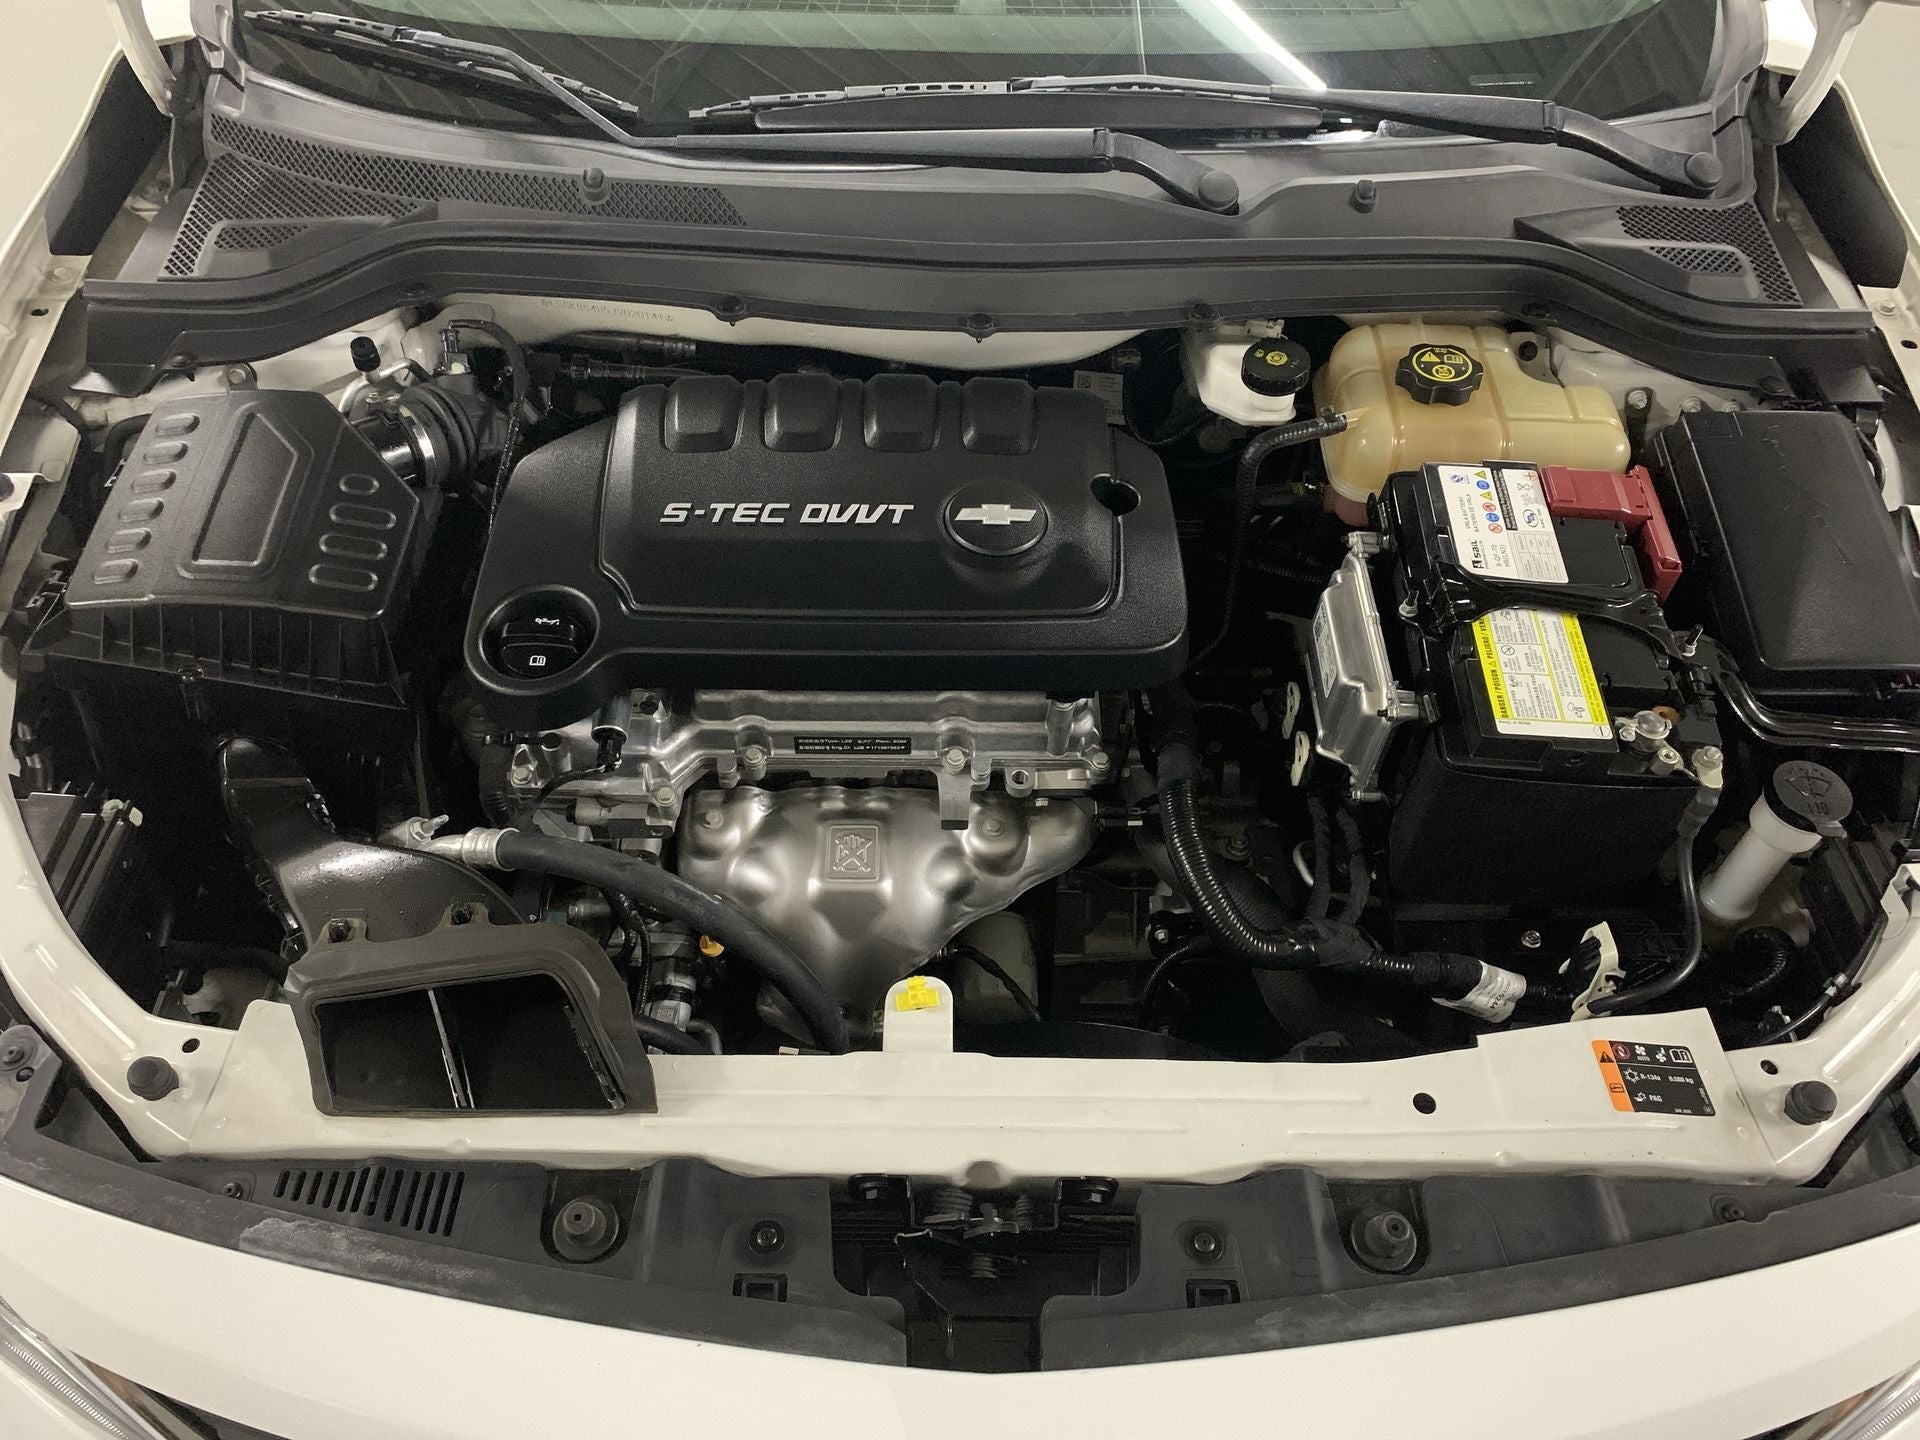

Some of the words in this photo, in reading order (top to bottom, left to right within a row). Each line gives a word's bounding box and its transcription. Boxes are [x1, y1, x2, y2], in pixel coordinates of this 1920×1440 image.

[660, 502, 790, 523] S-TEC
[1459, 496, 1467, 516] BATTERY
[1484, 636, 1493, 658] PELIGRO
[1492, 669, 1501, 690] POISON
[1498, 694, 1508, 717] DANGER
